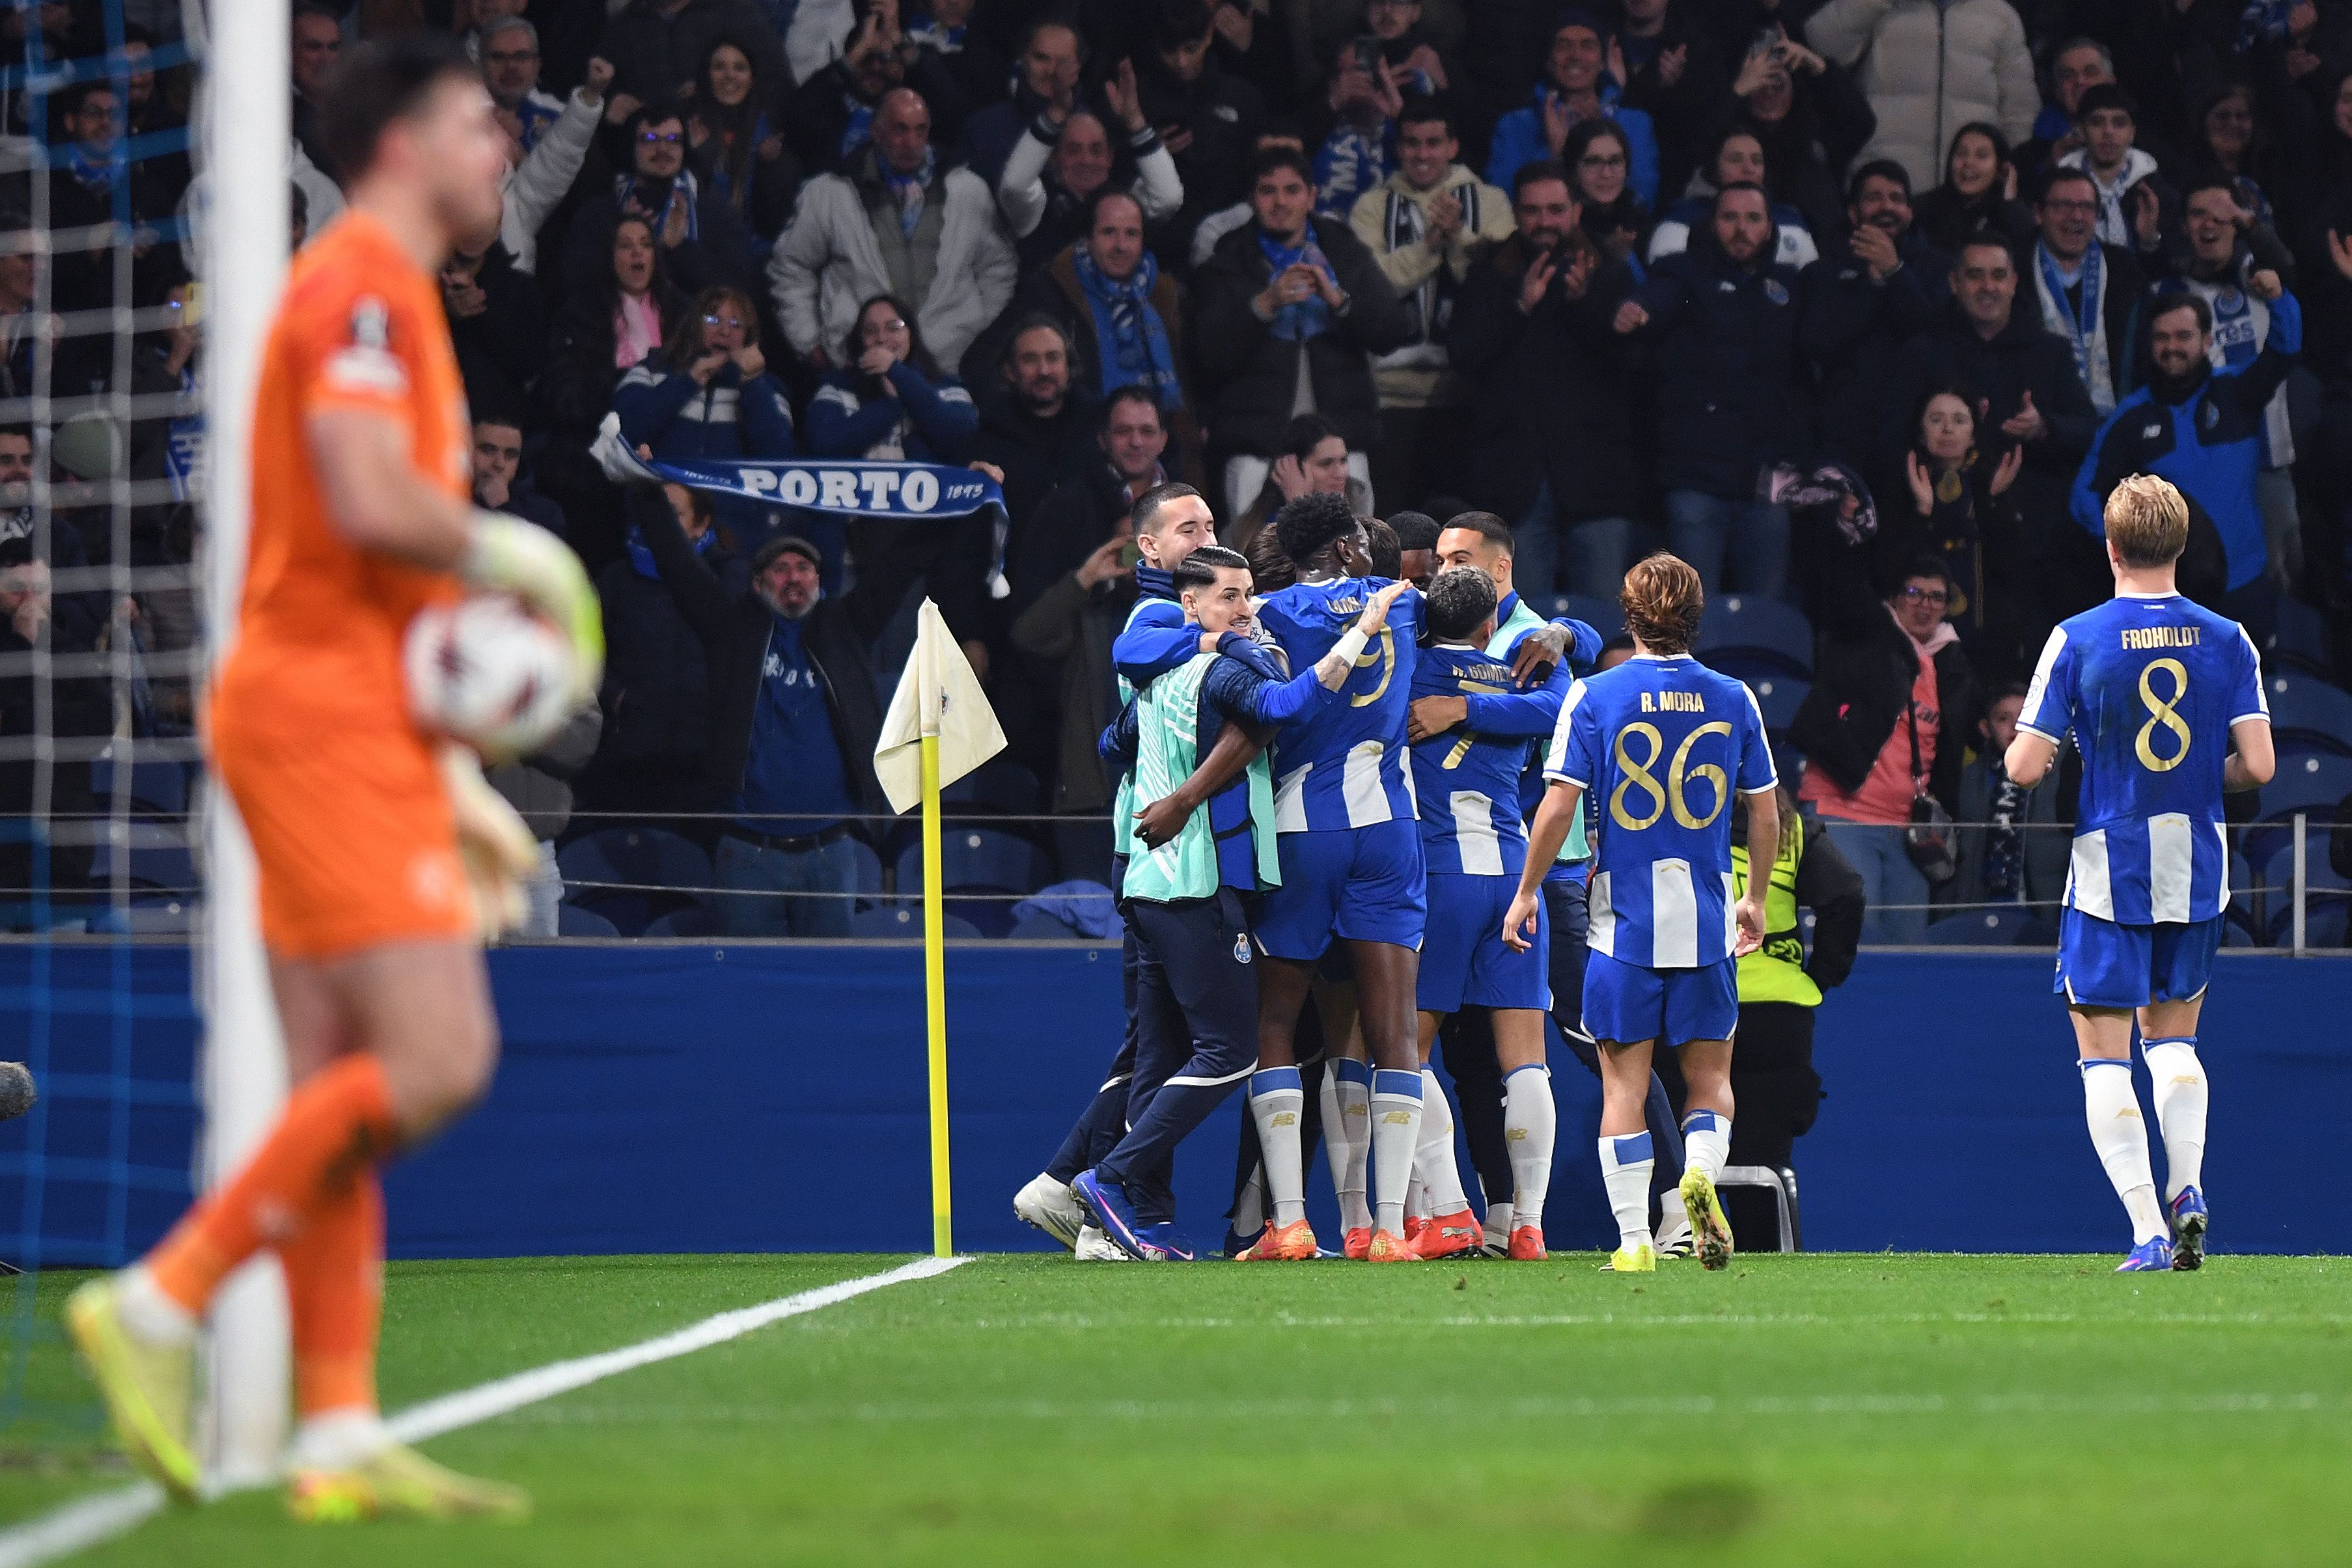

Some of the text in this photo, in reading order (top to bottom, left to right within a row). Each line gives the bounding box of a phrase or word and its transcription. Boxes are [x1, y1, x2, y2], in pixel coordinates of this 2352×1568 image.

[738, 469, 939, 512] PORTO
[947, 483, 984, 499] 1893
[1342, 611, 1395, 708] 9
[2120, 627, 2201, 650] FROHOLDT
[1640, 691, 1705, 713] R. MORA
[2135, 657, 2191, 772] 8
[1609, 721, 1732, 831] 86
